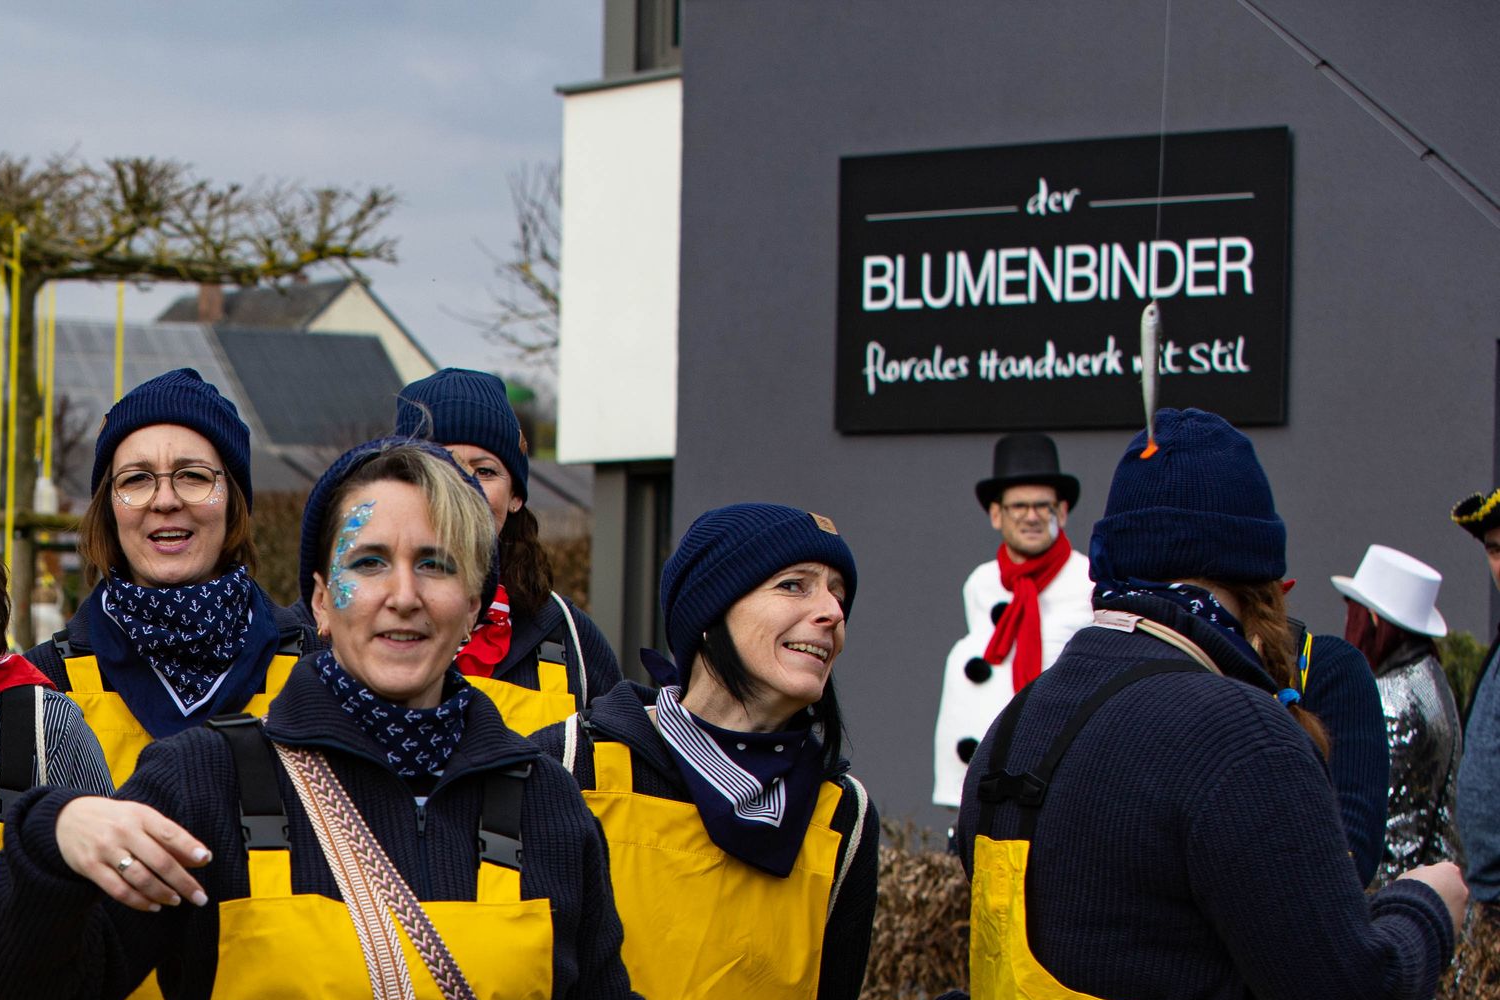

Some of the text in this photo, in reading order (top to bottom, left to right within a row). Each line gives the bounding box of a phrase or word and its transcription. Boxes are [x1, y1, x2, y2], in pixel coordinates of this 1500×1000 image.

[1026, 177, 1080, 216] der
[862, 236, 1254, 311] BLUMENBINDER
[863, 341, 969, 395] florales
[978, 335, 1124, 382] Handwerk
[1188, 336, 1250, 373] Stil
